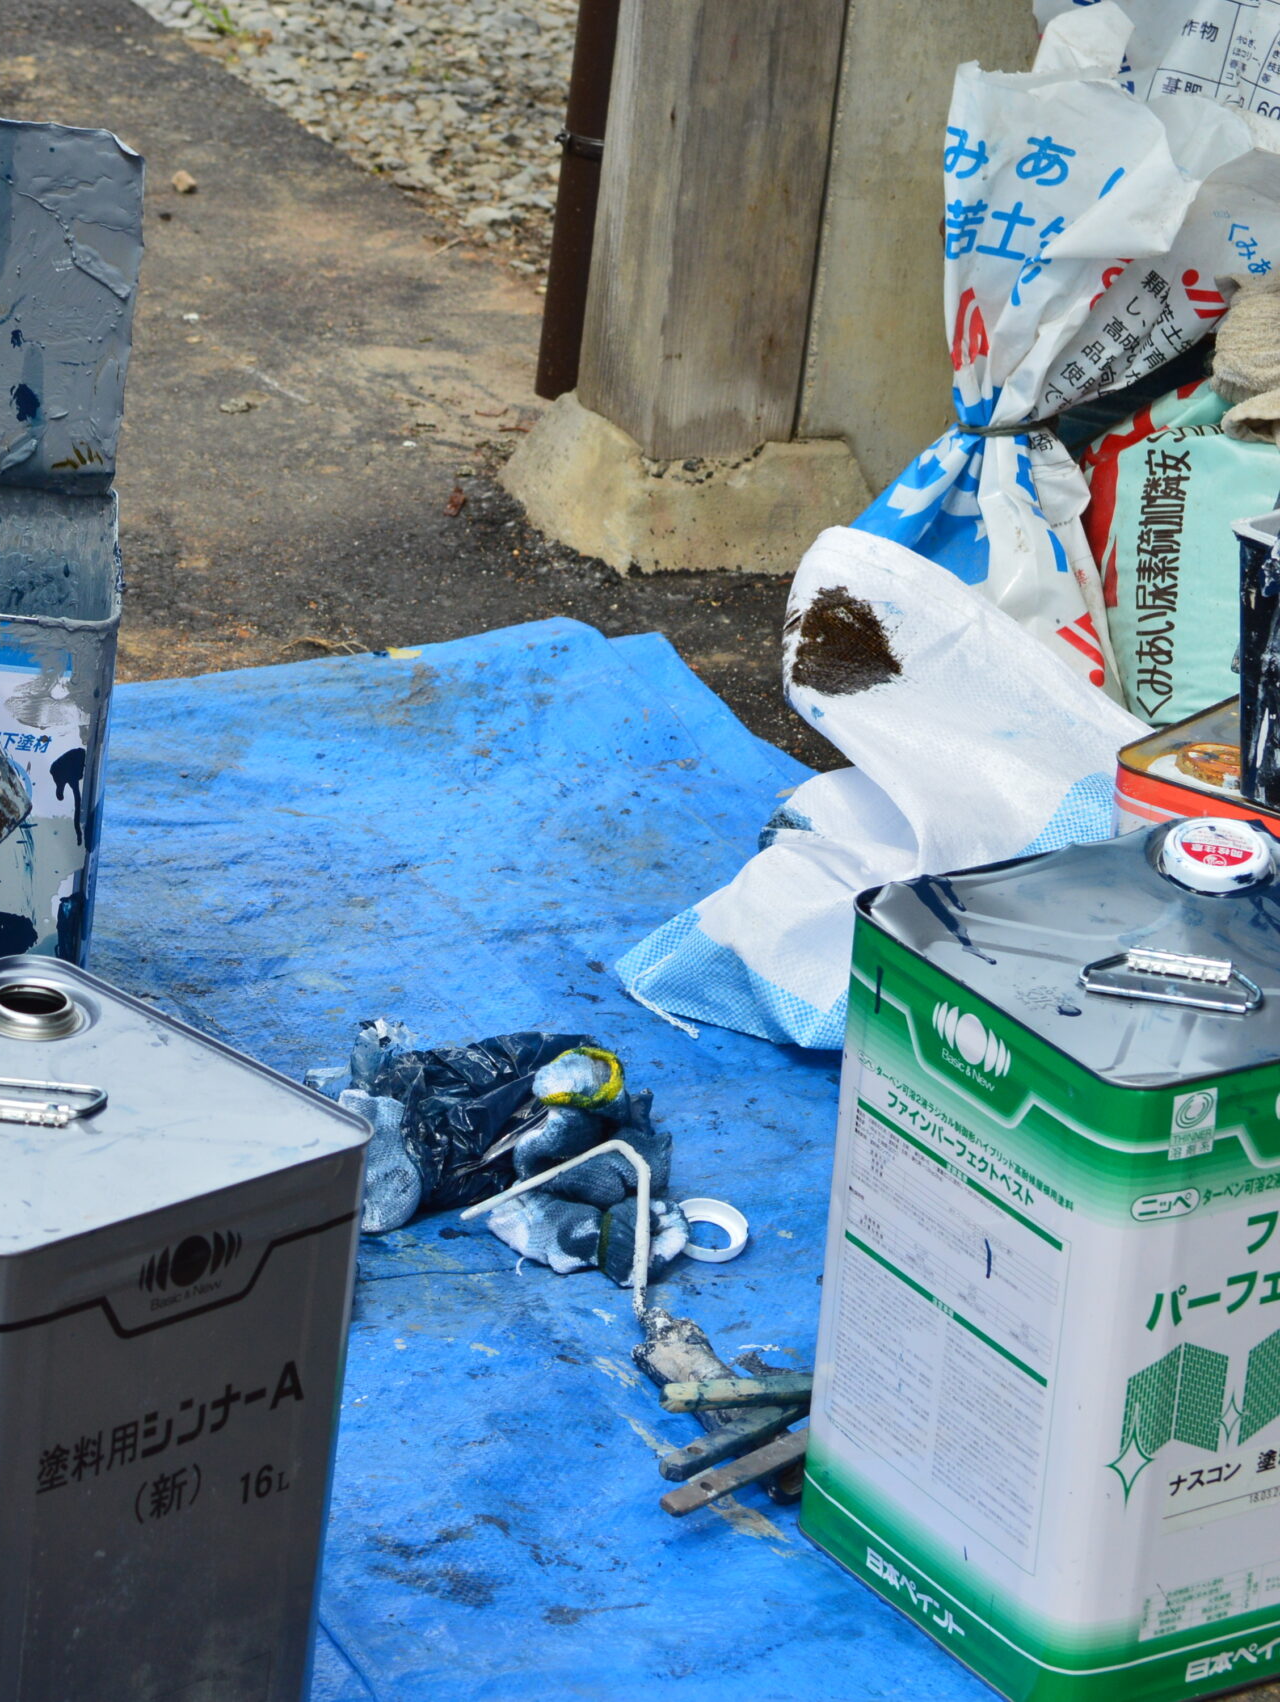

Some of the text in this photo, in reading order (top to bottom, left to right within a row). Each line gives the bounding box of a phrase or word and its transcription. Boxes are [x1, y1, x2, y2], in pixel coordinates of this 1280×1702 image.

[1181, 20, 1219, 42] 作物
[1228, 223, 1273, 276] くみあ
[941, 1047, 965, 1072] Basic
[972, 1071, 996, 1092] New
[1173, 1127, 1212, 1144] THINNER
[1138, 1191, 1192, 1217] ニッペ
[240, 1464, 289, 1504] 16L
[1169, 1448, 1280, 1497] ナスコン 塗
[865, 1547, 966, 1637] 日本ペイント
